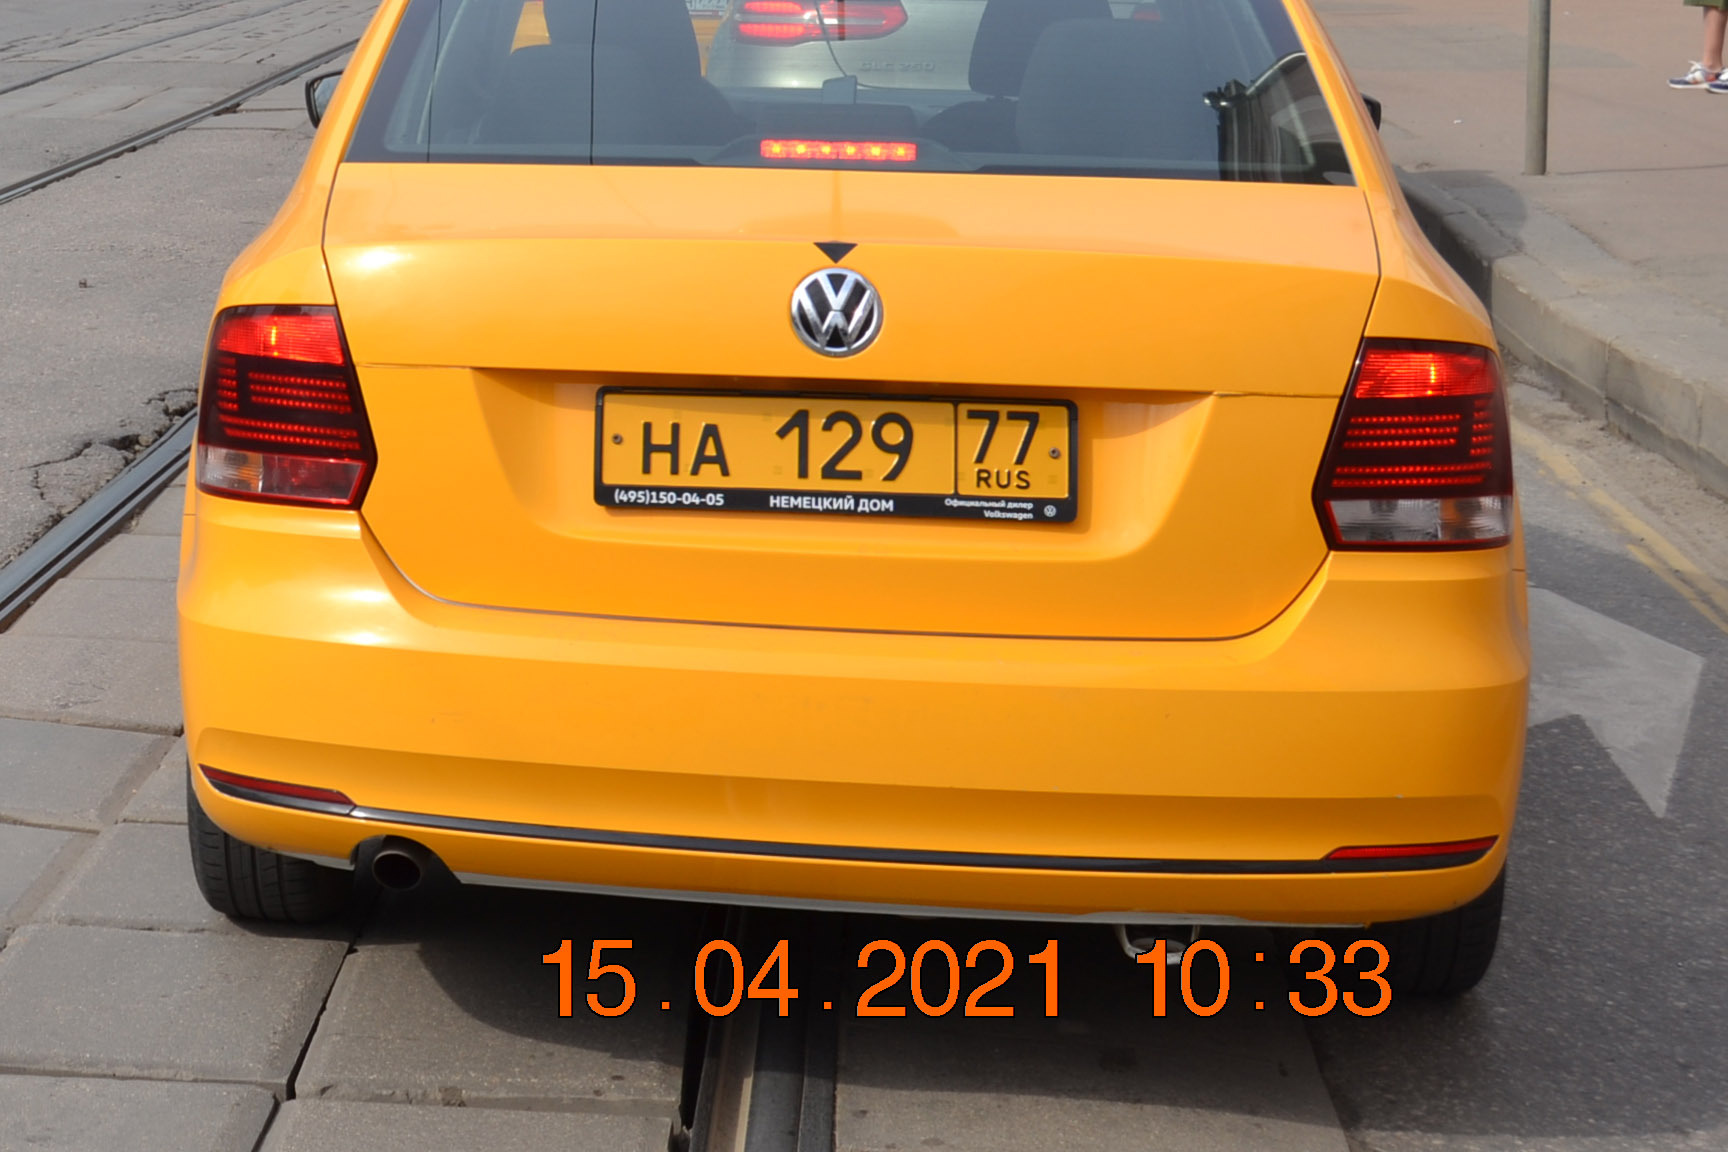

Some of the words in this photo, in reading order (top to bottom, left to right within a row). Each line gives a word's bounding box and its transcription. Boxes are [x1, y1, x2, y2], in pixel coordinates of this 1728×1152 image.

[641, 421, 730, 477] НА
[775, 408, 914, 482] 129
[966, 409, 1041, 465] 77
[975, 468, 1032, 490] RUS
[614, 488, 724, 507] (495)150-04-05
[769, 494, 855, 512] НЕМЕЦКИЙ
[857, 498, 894, 514] ДОМ
[984, 510, 1033, 520] Volkswagen
